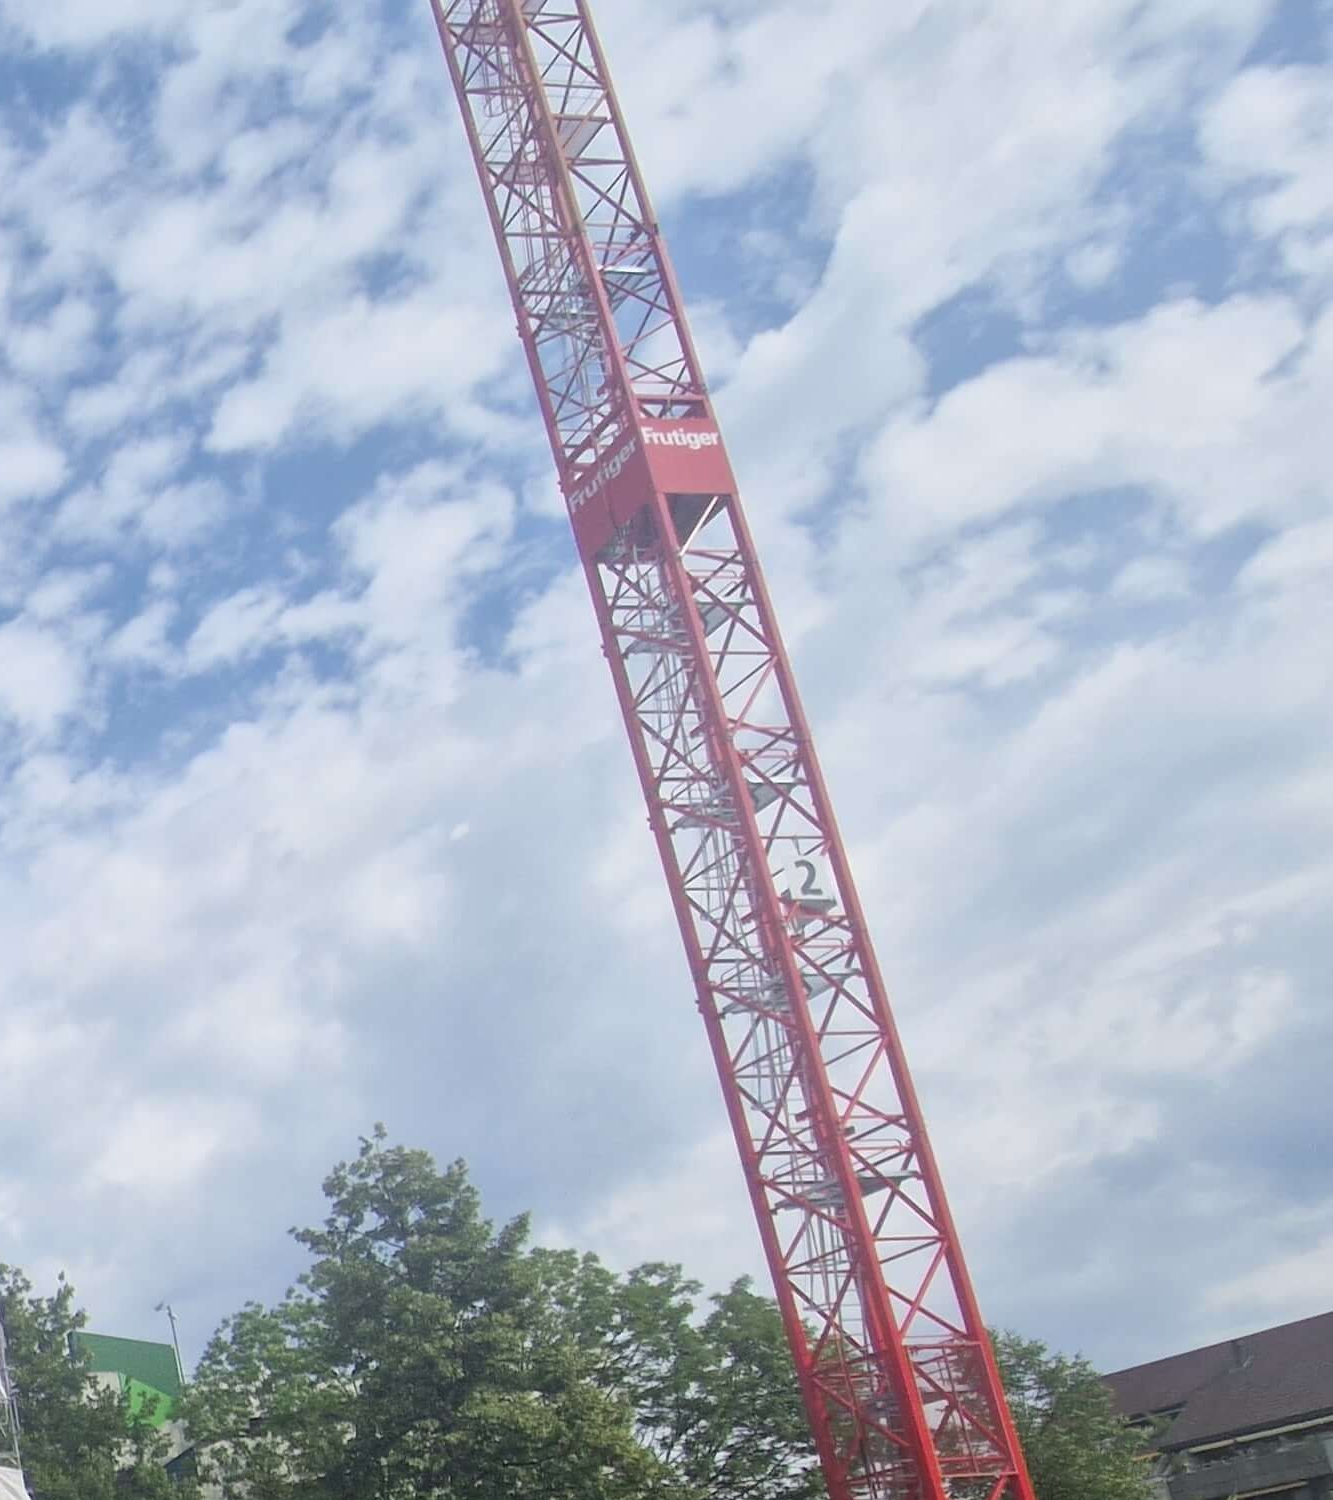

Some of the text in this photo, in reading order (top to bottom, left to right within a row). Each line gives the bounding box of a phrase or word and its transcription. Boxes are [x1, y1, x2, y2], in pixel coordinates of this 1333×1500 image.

[641, 426, 719, 450] Frutiger
[568, 438, 637, 513] Frutiger
[794, 859, 823, 895] 2
